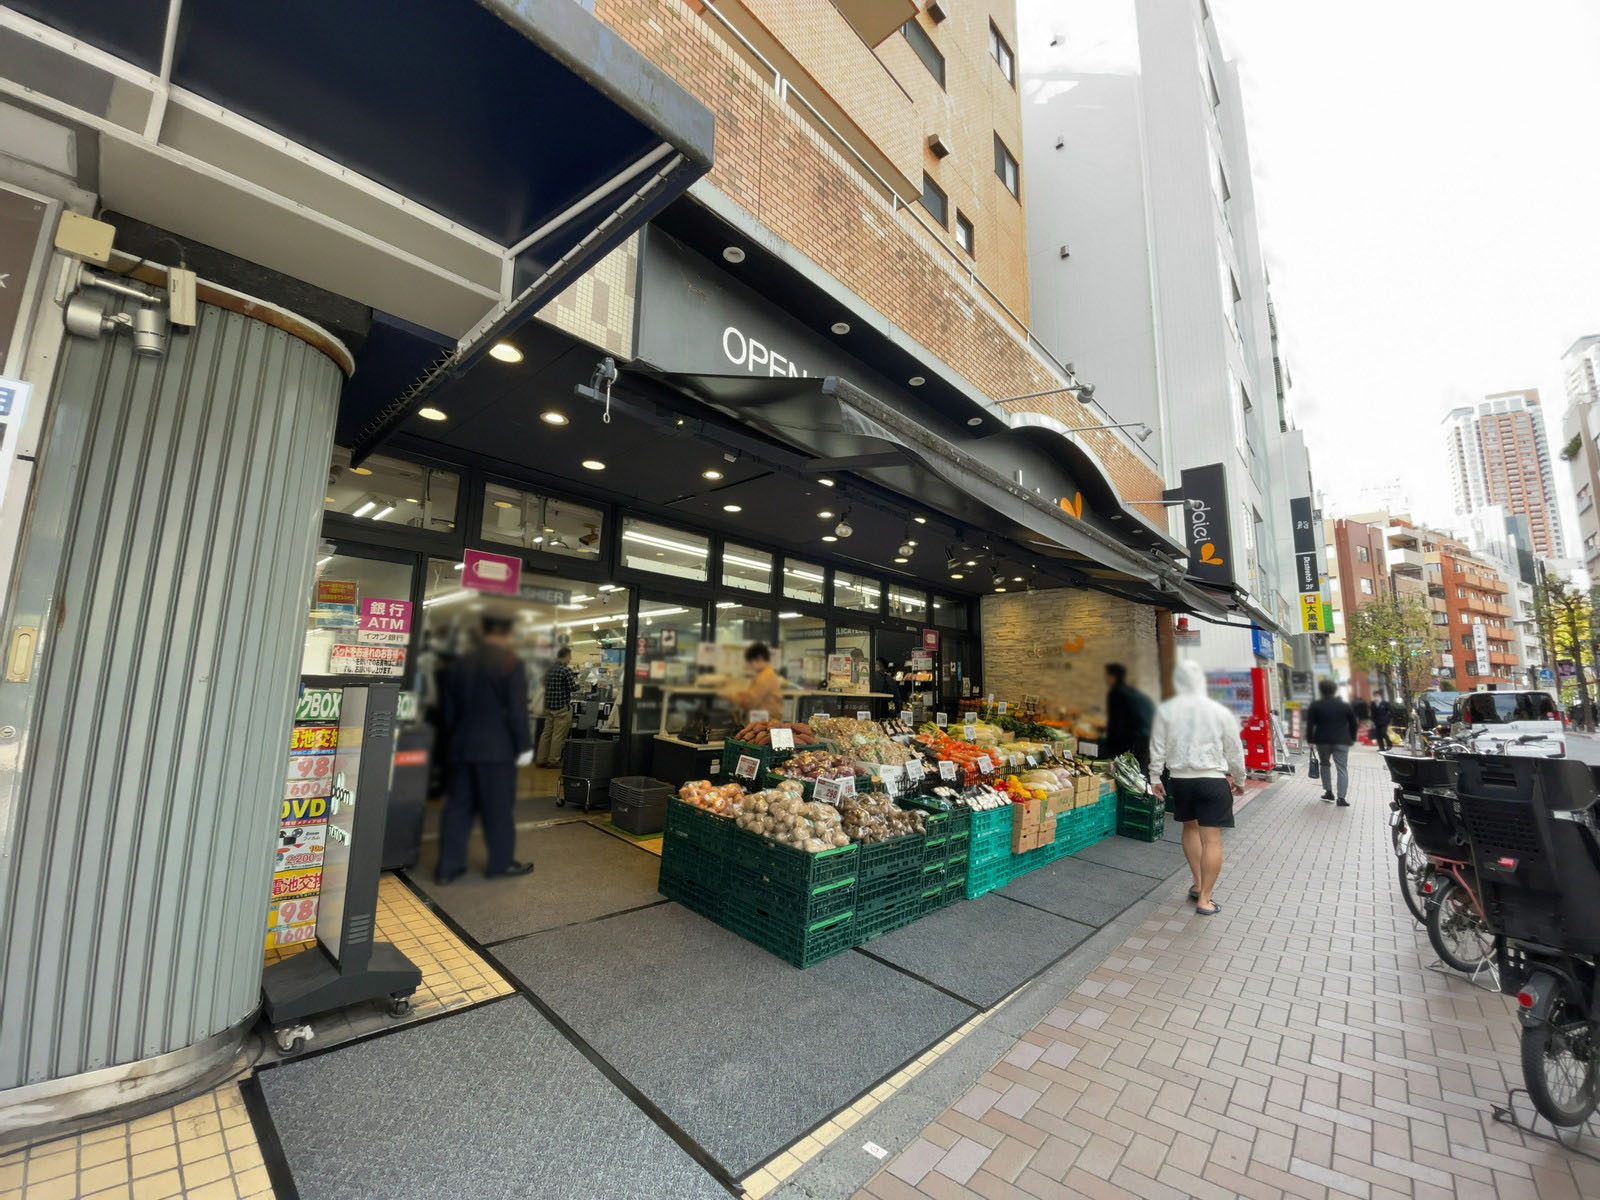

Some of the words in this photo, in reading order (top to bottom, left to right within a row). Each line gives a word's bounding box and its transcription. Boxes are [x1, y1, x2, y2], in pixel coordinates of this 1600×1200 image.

[1192, 499, 1211, 544] daiei
[369, 601, 405, 617] 銀行
[1306, 605, 1318, 631] 大黒屋
[367, 616, 405, 631] ATM
[363, 632, 405, 642] イオン銀行
[297, 756, 334, 778] 98
[280, 899, 318, 923] 98
